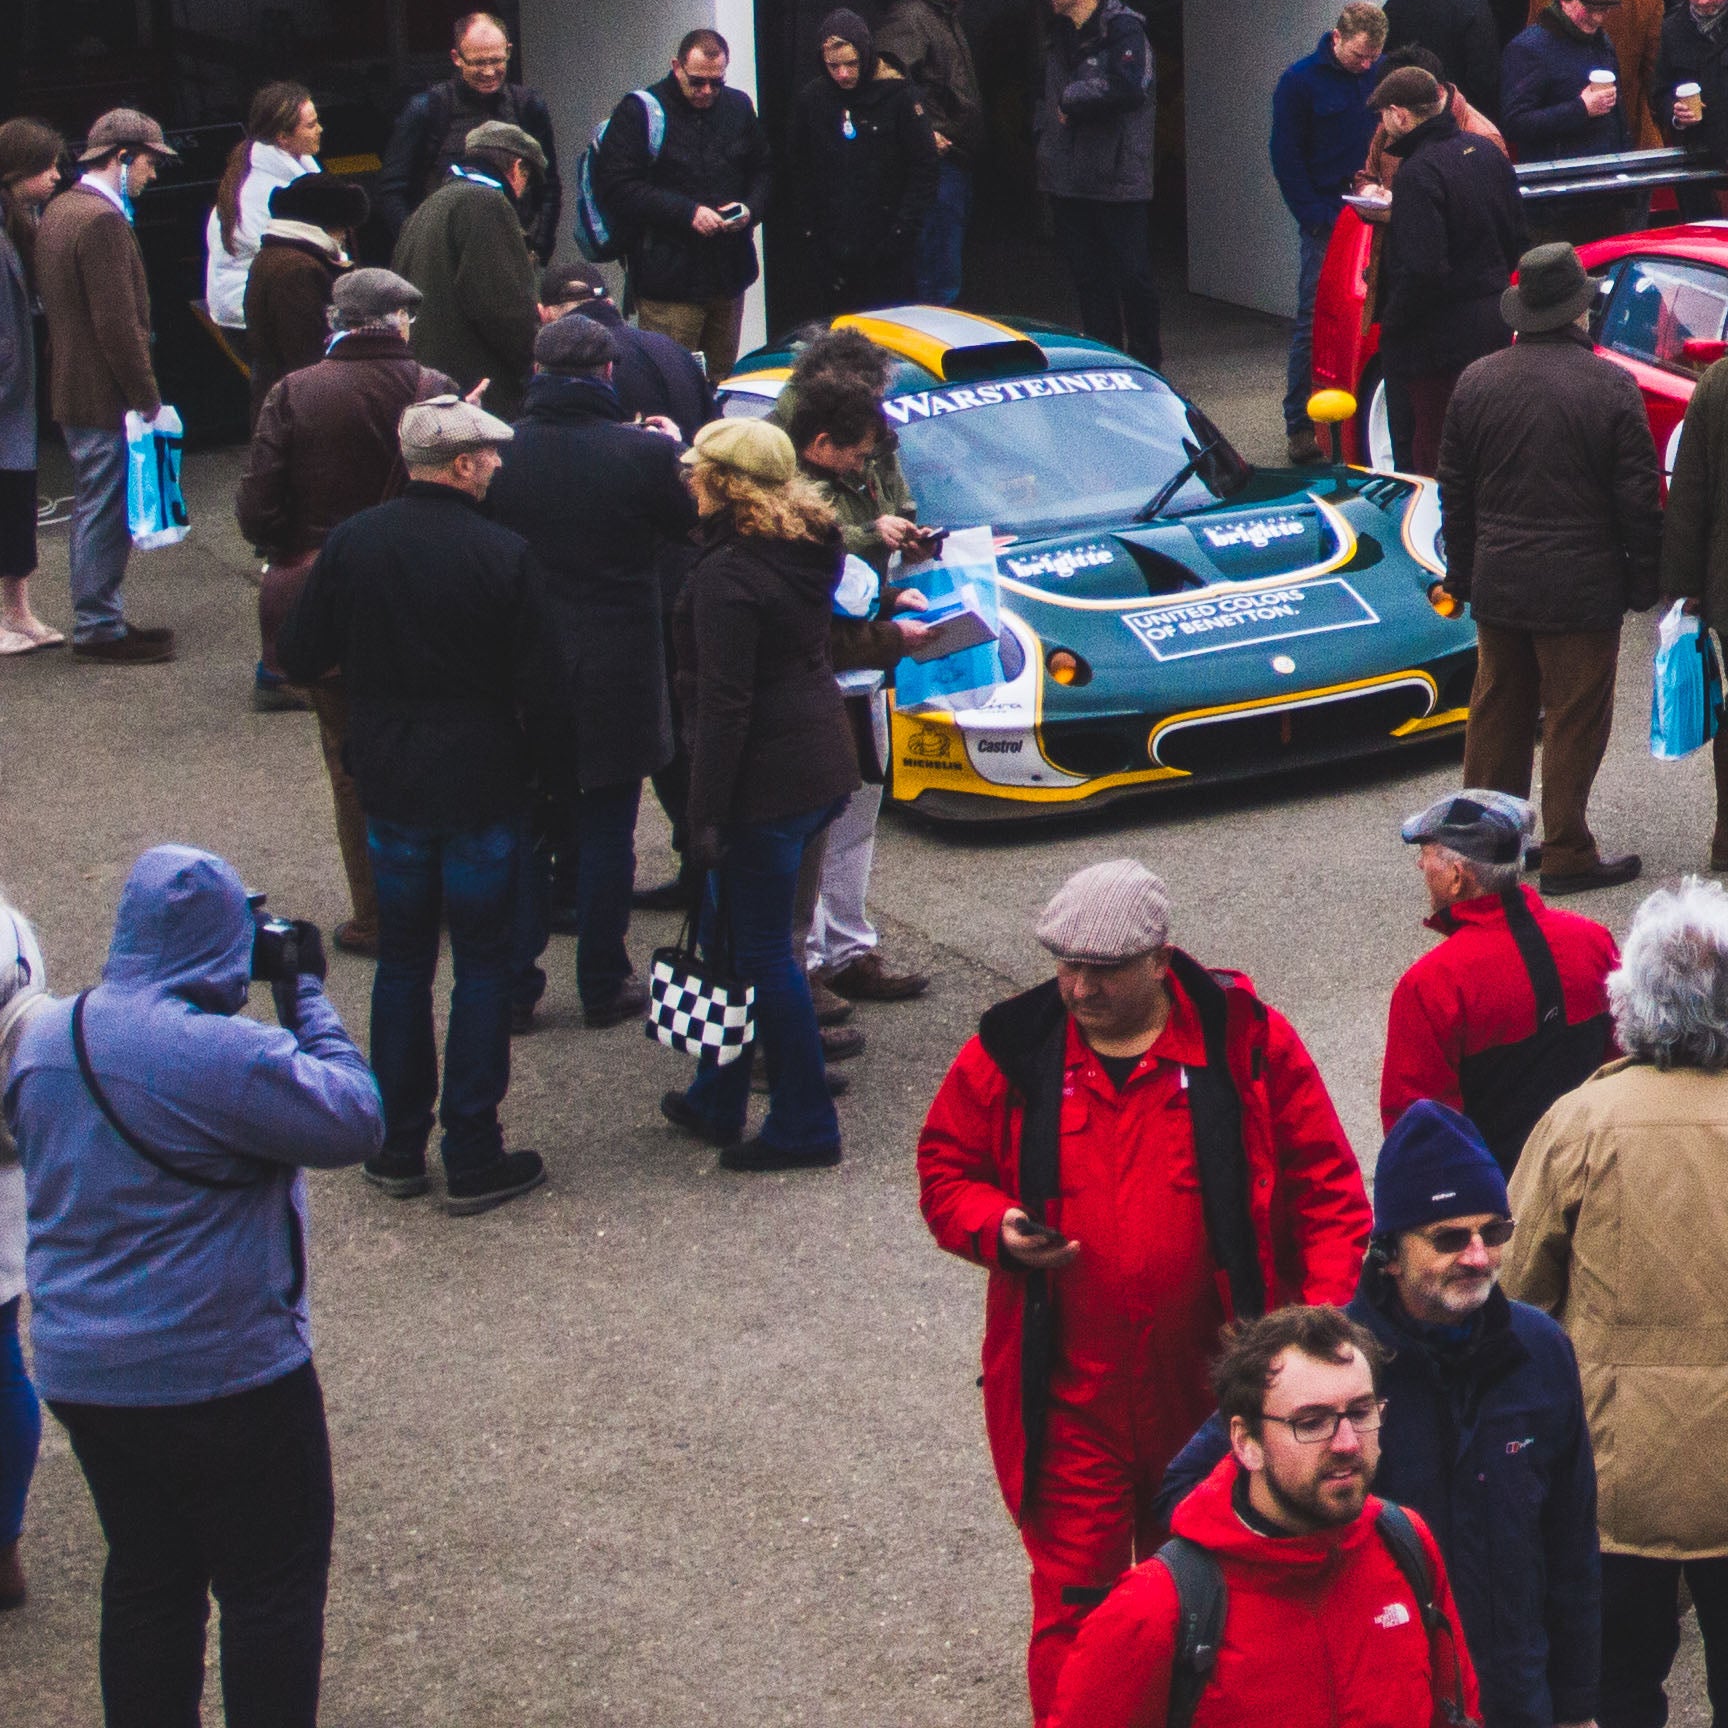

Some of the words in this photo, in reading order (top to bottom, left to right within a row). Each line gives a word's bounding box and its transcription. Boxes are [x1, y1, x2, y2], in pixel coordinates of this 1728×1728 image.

[881, 371, 1144, 425] WARSTEINER
[1133, 604, 1217, 629] UNITED
[1218, 589, 1305, 613] COLORS
[1145, 625, 1177, 641] OF
[1178, 604, 1300, 635] BENETTON.
[903, 757, 963, 771] MICHELIN
[977, 739, 1023, 754] Castrol
